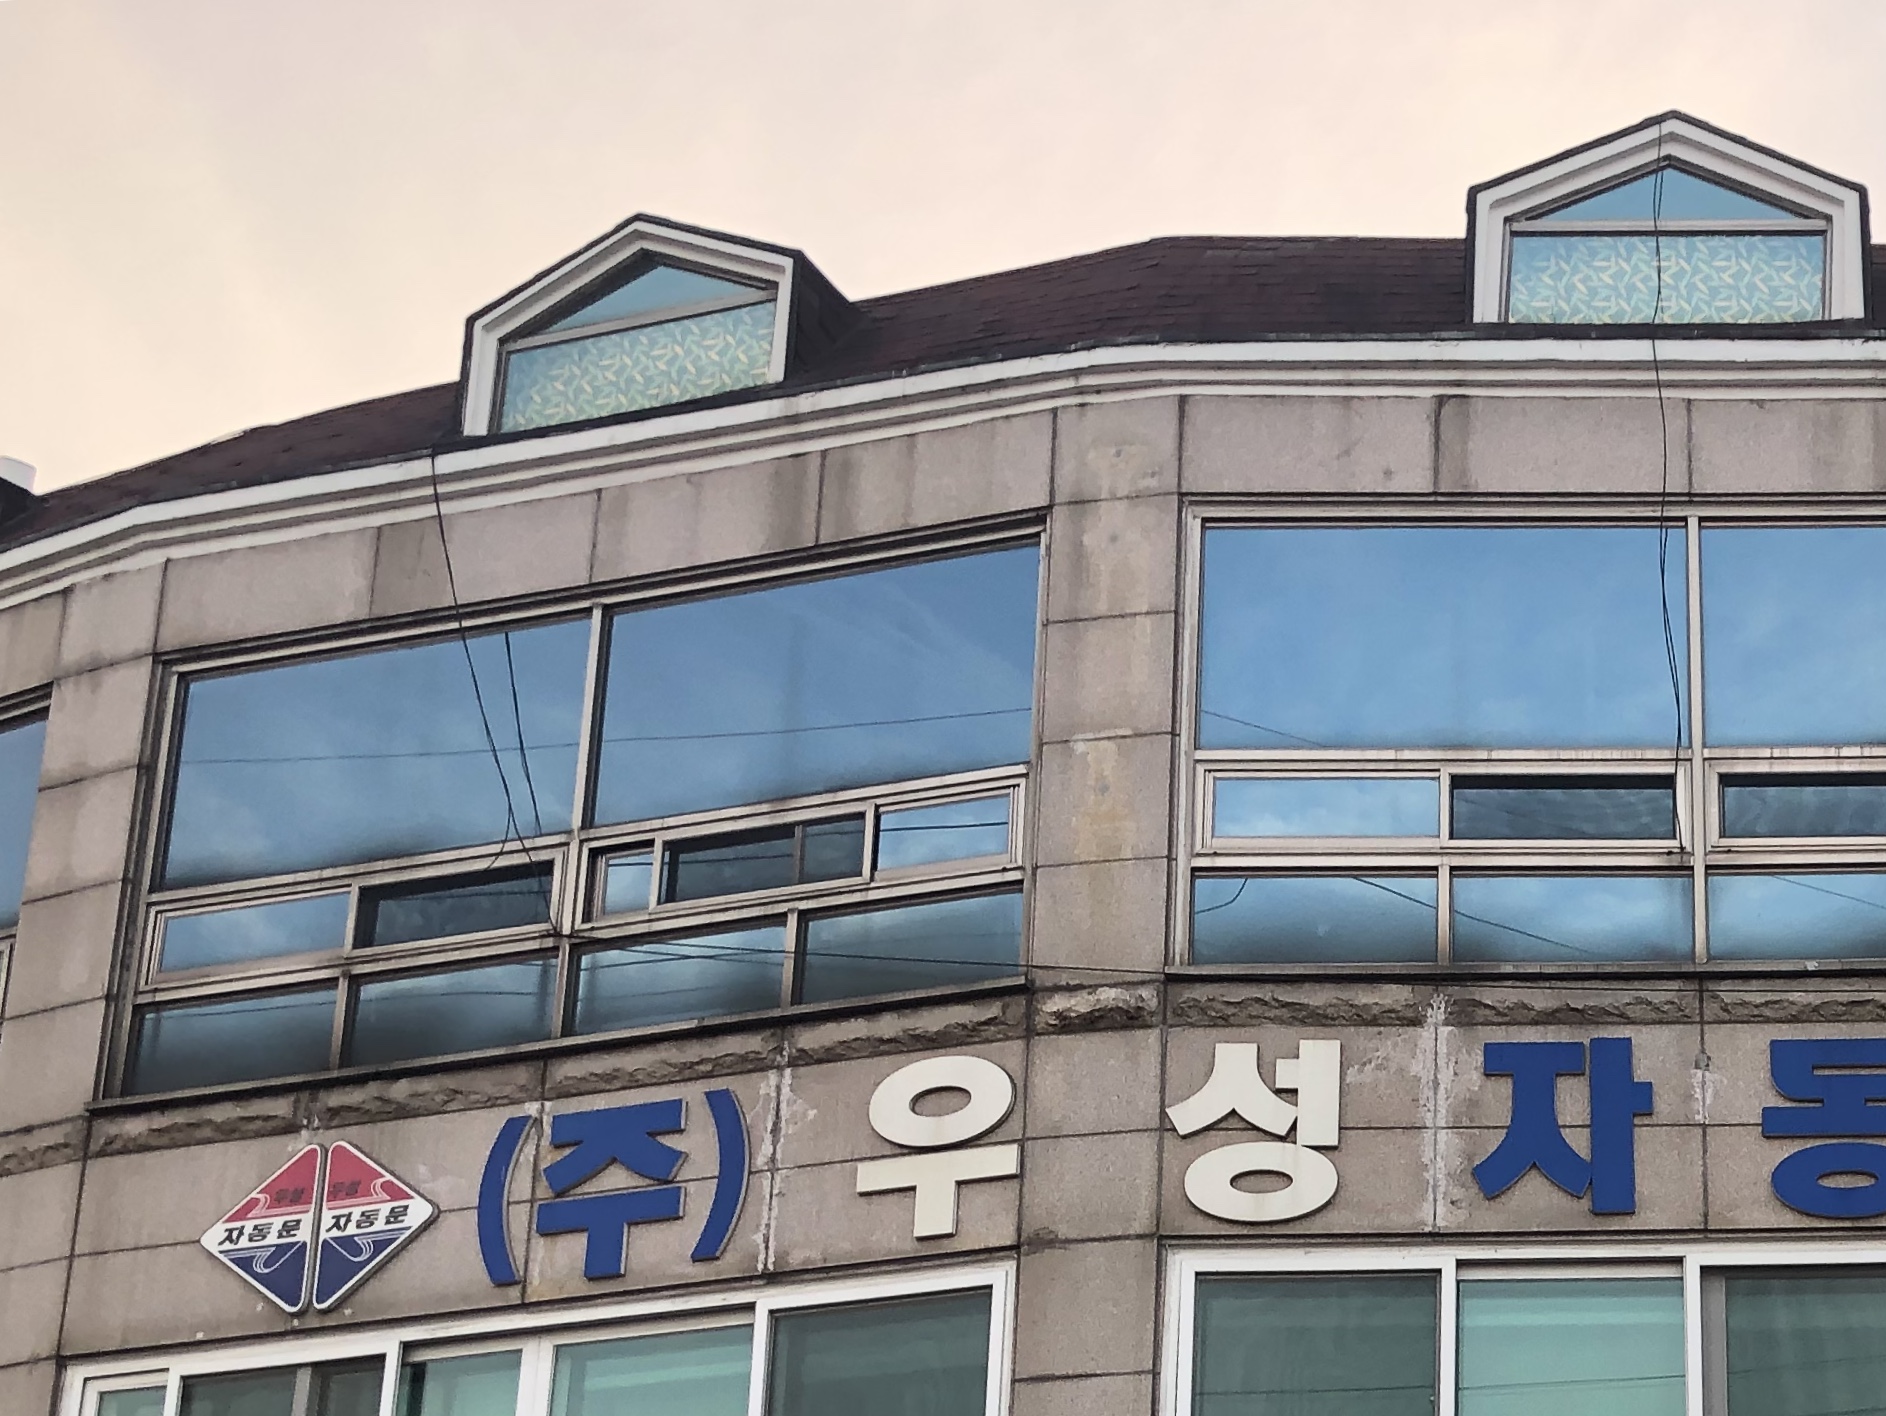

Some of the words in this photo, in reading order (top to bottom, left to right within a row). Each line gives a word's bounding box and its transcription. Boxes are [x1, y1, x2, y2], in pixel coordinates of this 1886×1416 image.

[477, 1088, 750, 1285] (주)
[217, 1218, 303, 1247] 자동문
[325, 1204, 410, 1233] 자동문
